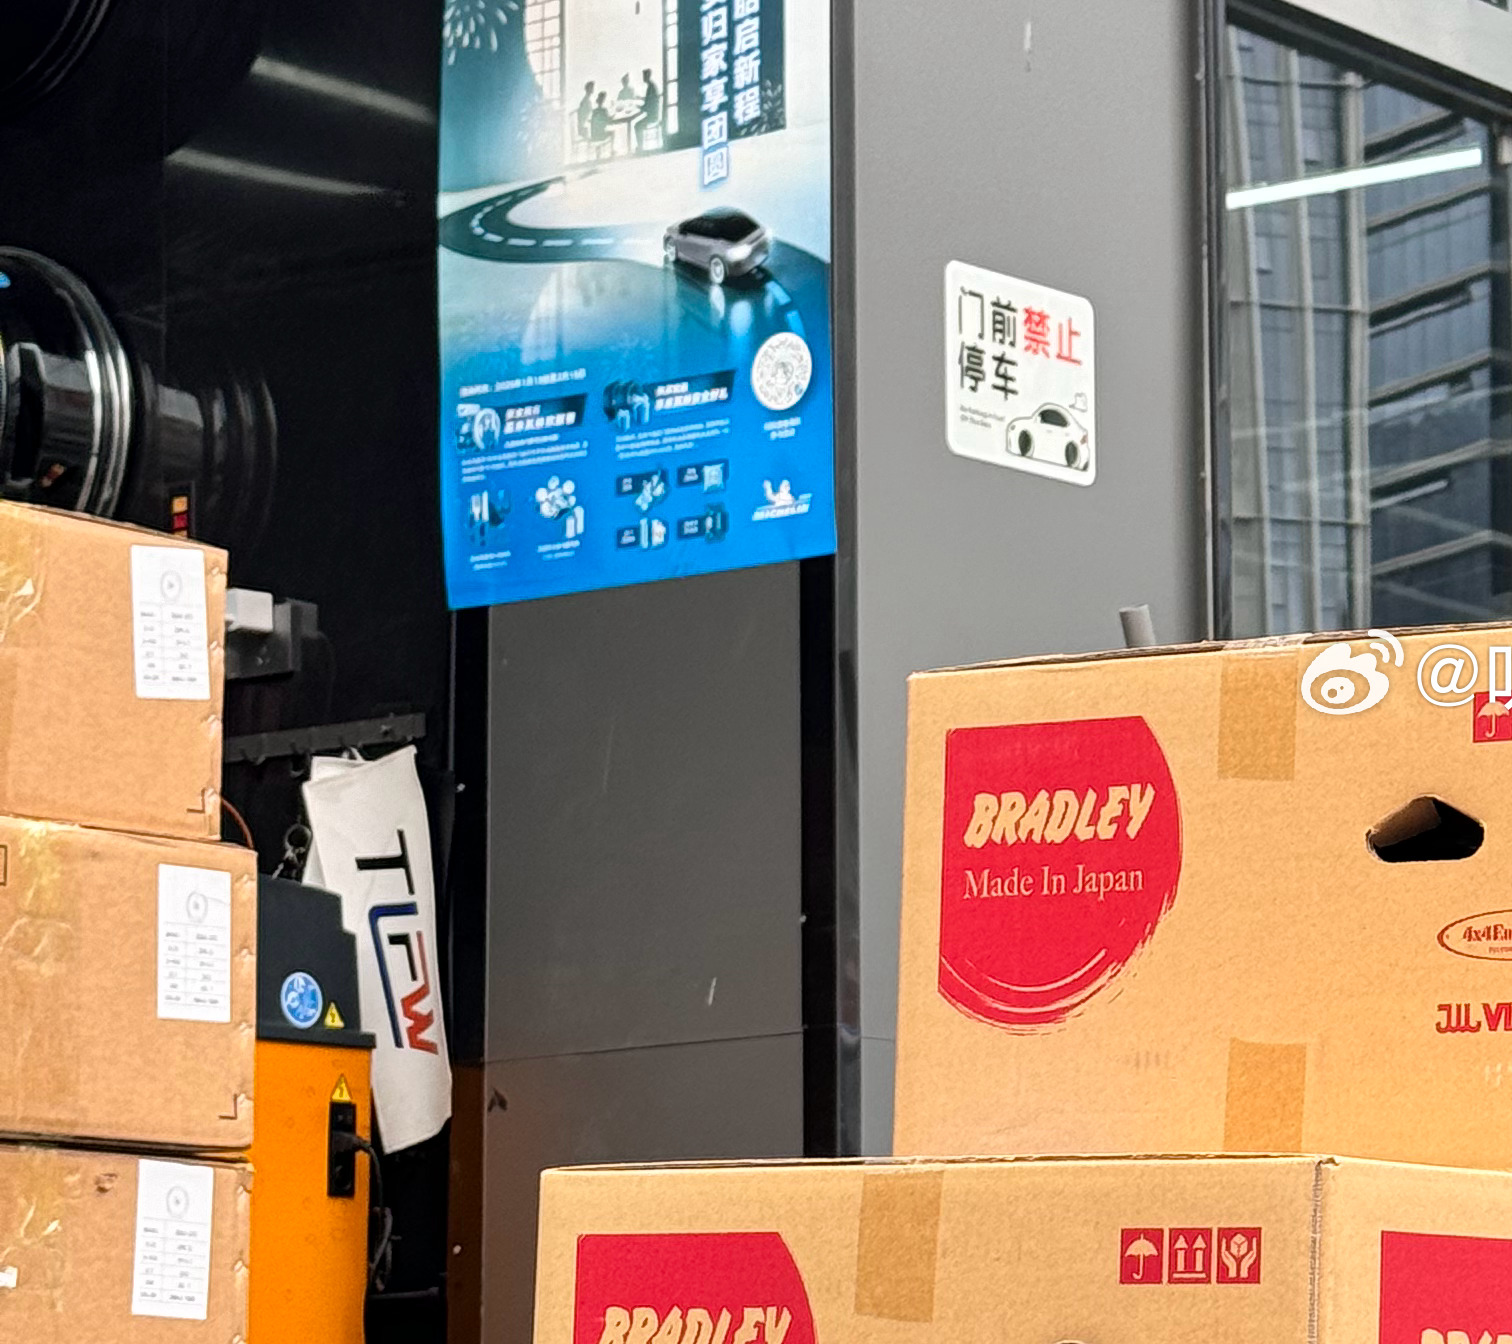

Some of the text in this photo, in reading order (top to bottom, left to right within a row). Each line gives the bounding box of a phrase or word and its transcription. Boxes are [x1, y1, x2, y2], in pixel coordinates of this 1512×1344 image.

[958, 341, 1019, 401] 停车
[963, 783, 1156, 848] BRADLEY
[963, 864, 1143, 901] Made In Japan
